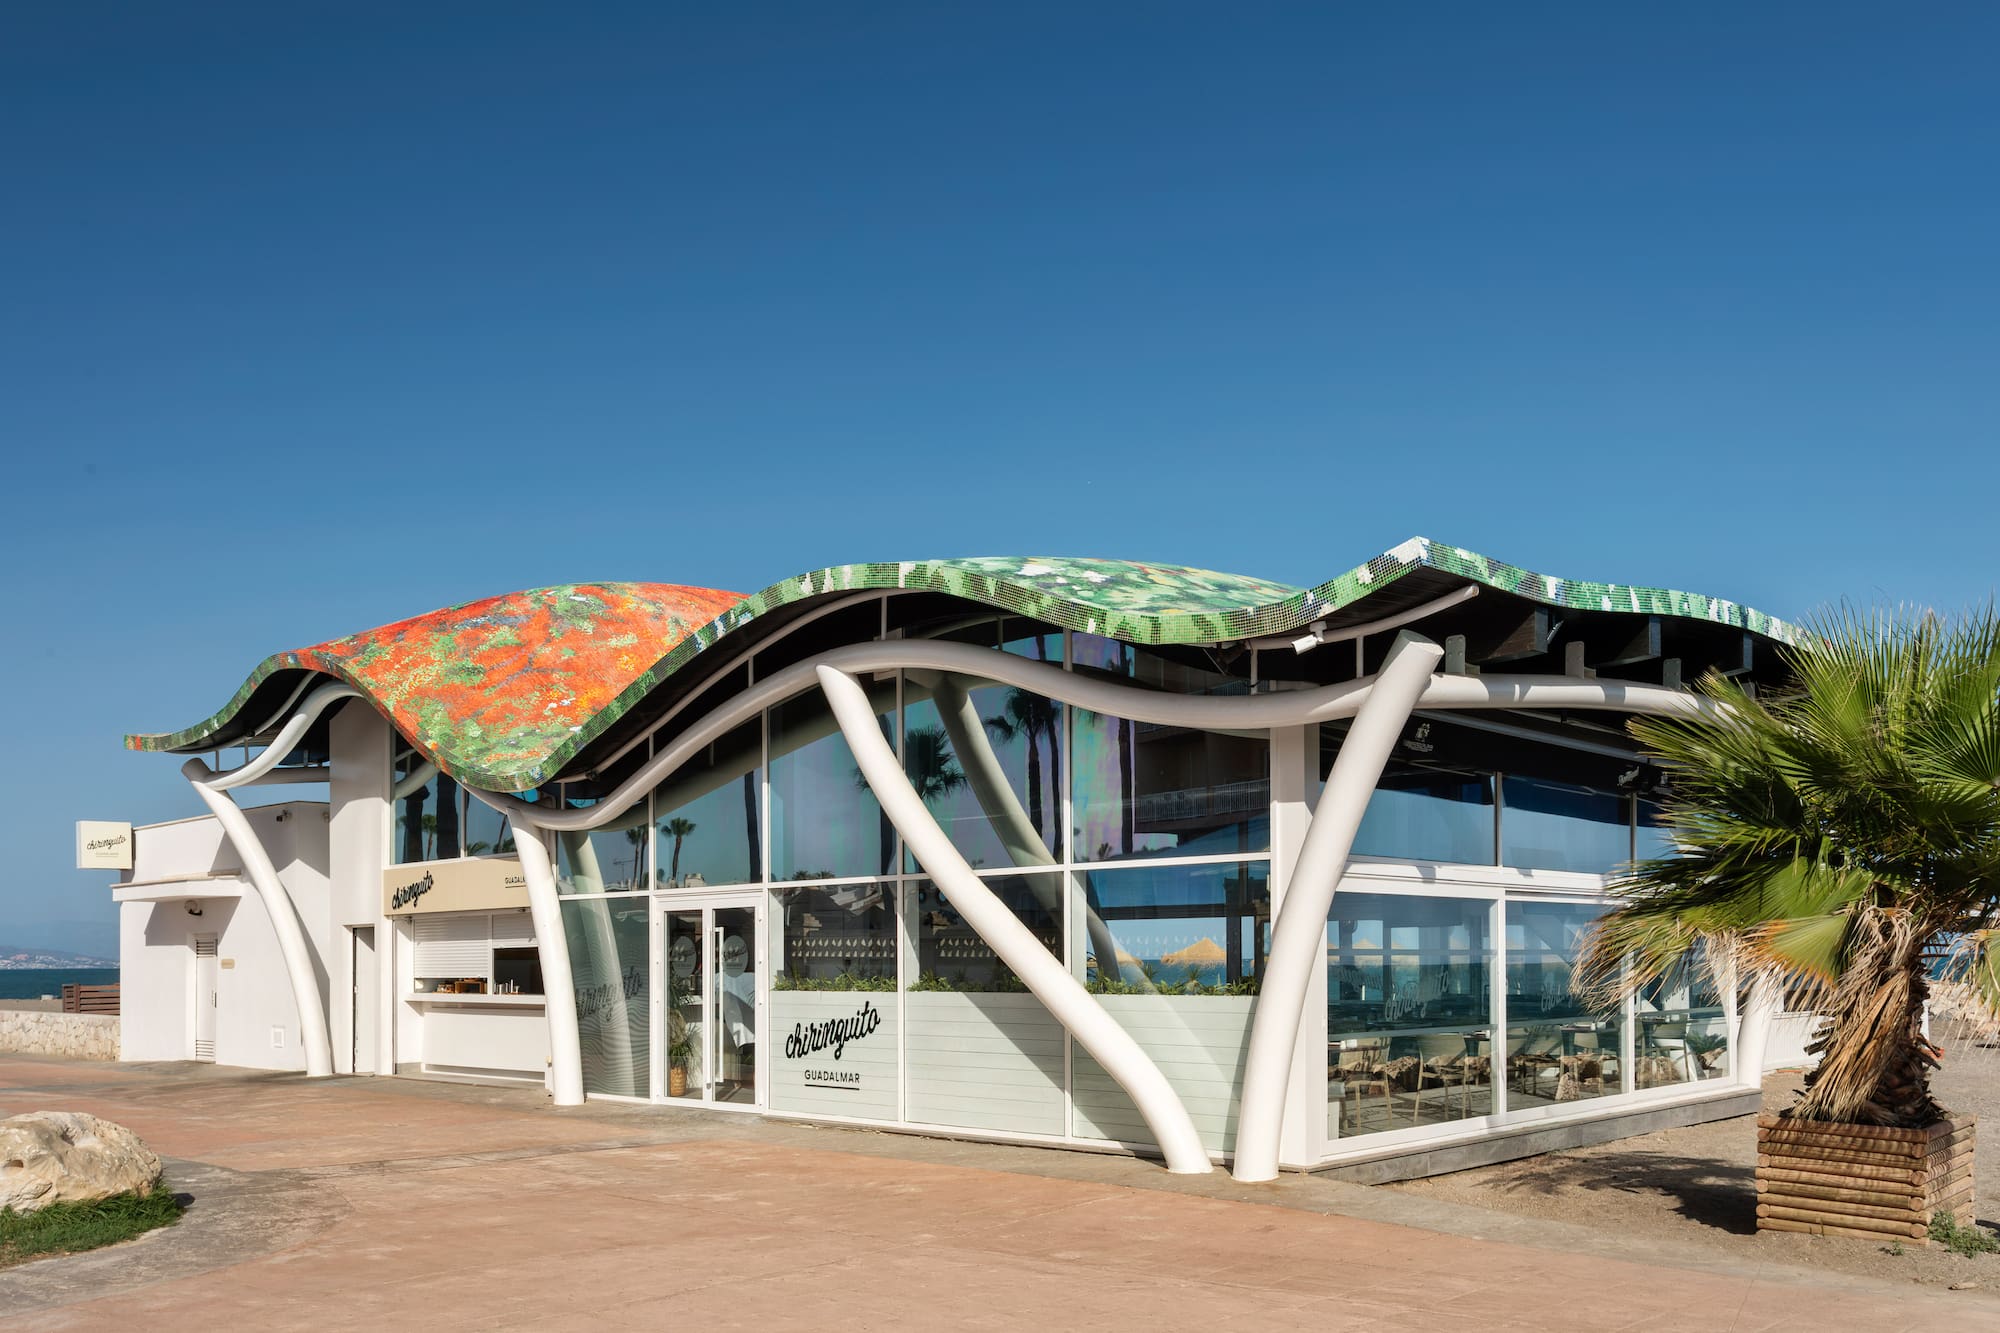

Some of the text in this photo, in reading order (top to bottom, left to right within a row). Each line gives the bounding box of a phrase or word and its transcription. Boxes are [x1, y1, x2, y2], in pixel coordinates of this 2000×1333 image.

[391, 870, 434, 909] chiringuito
[785, 1000, 881, 1060] chiringuito
[804, 1069, 860, 1083] GUADALMAR
